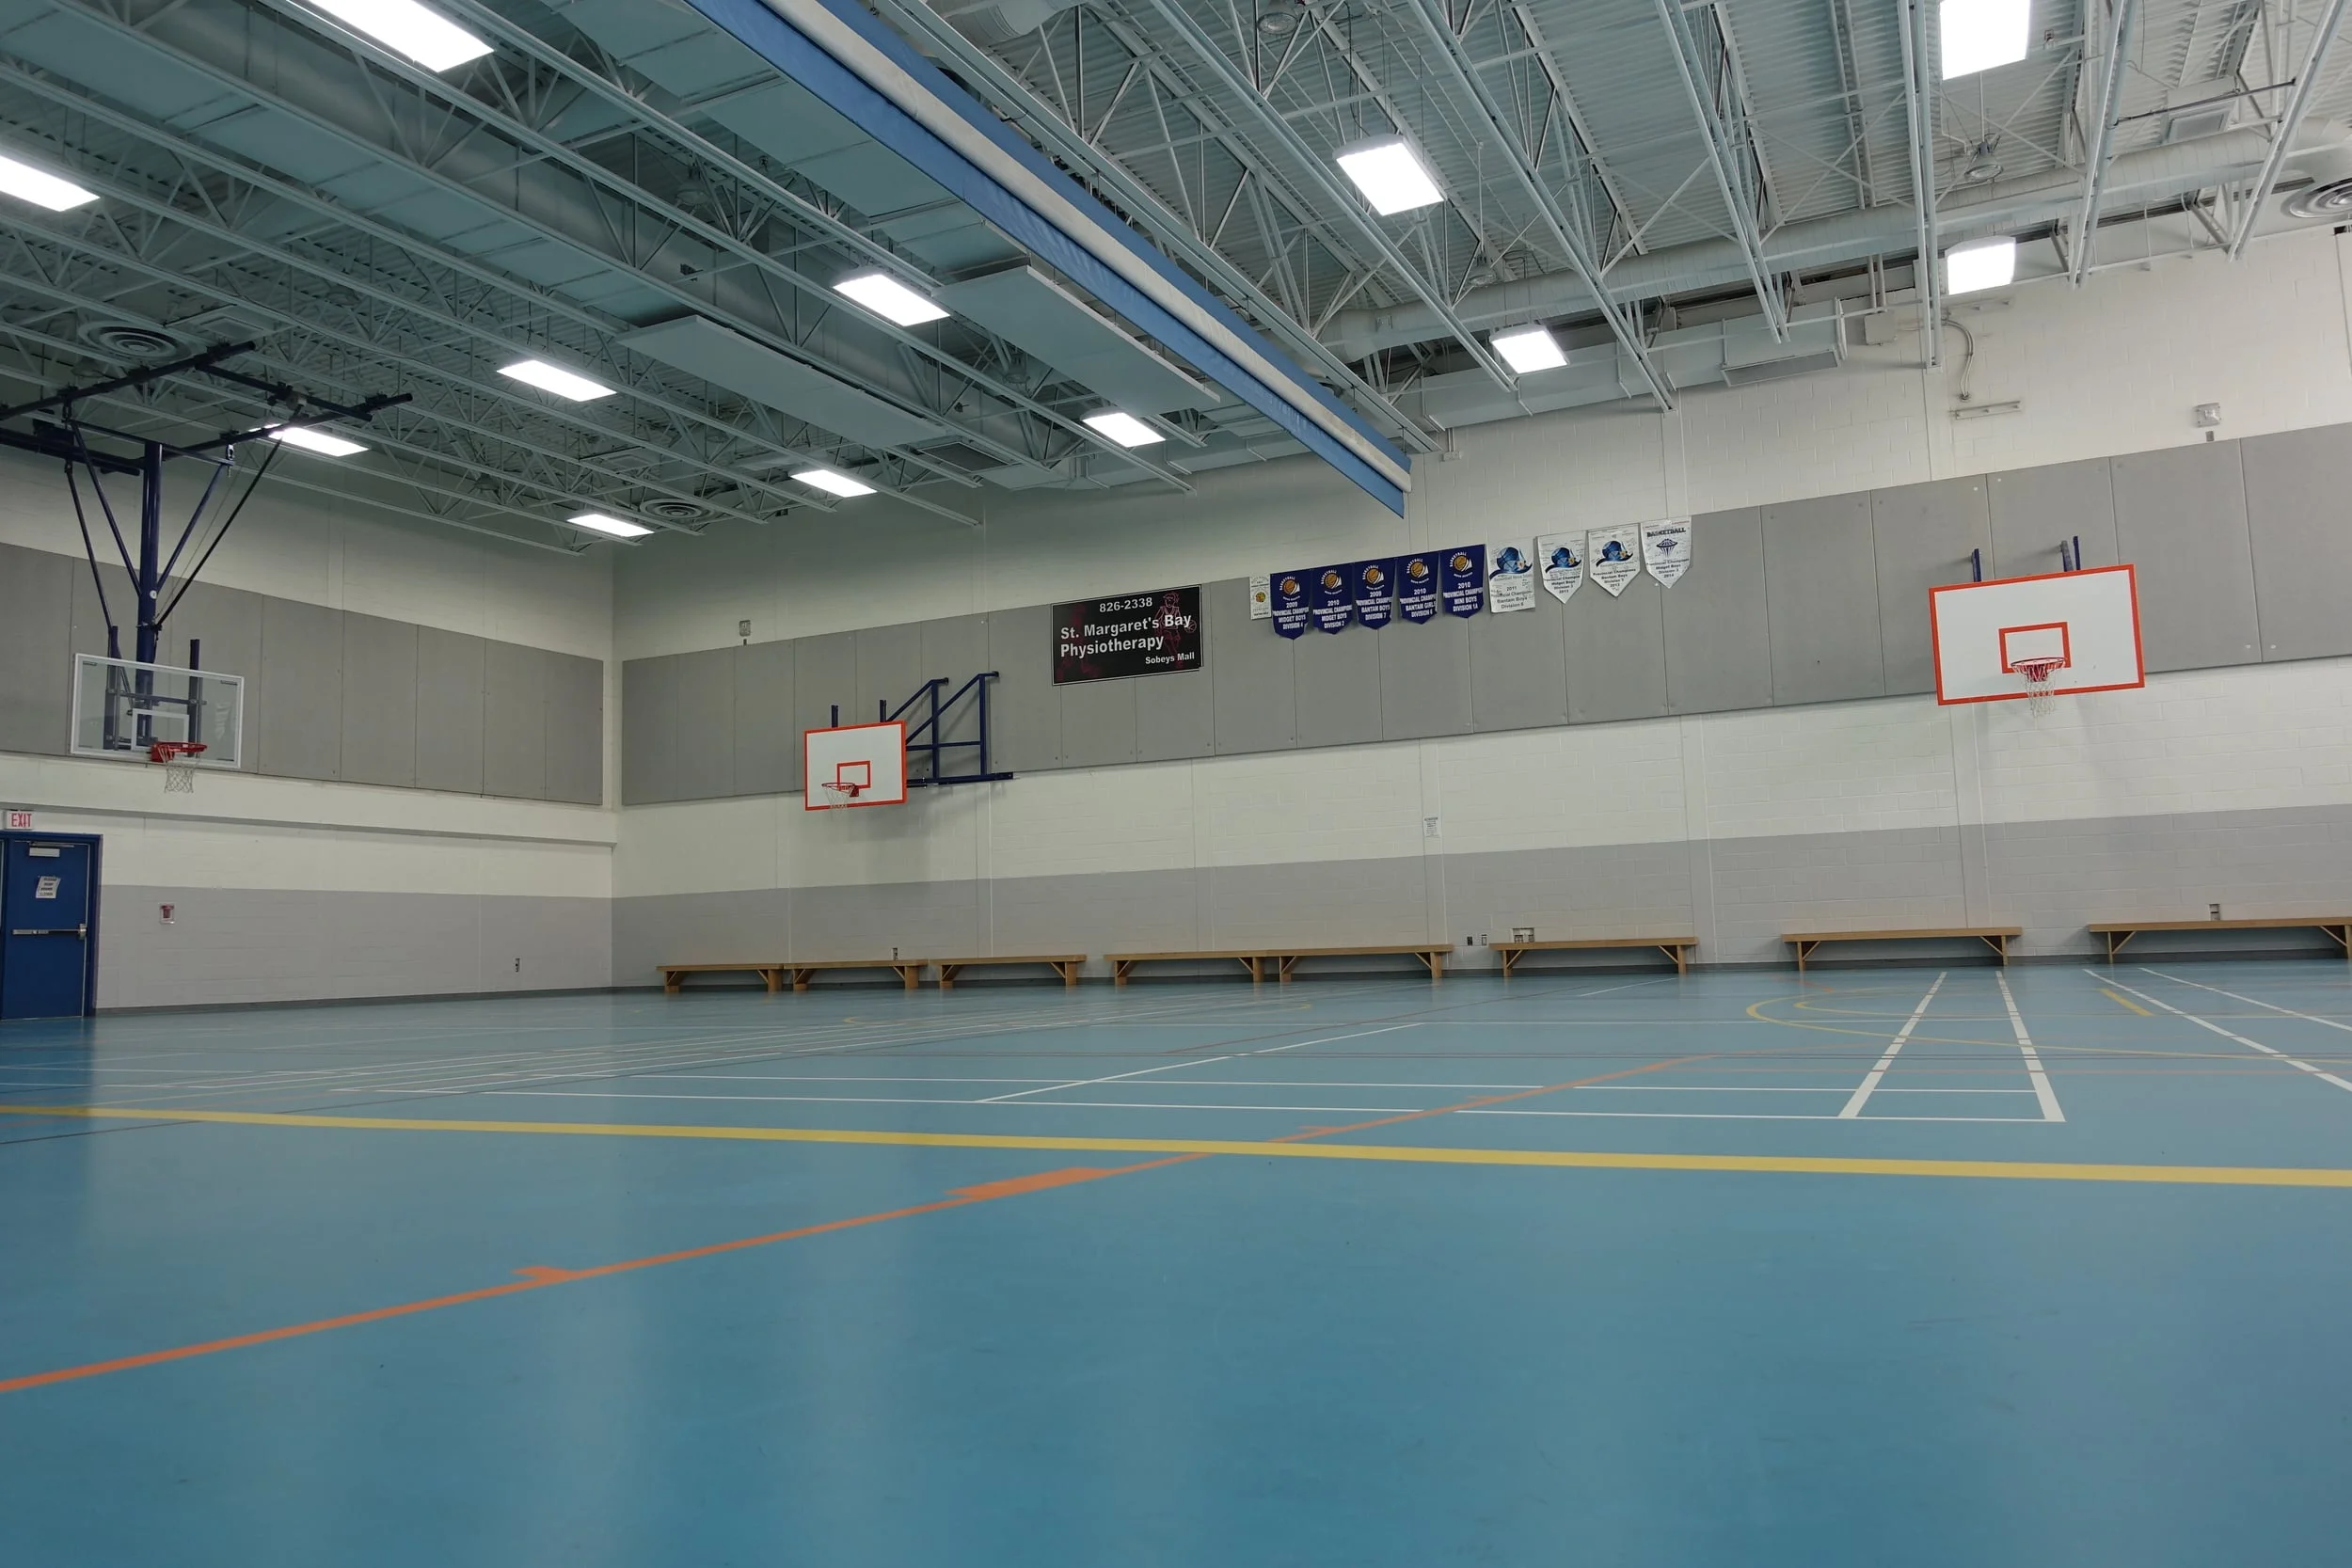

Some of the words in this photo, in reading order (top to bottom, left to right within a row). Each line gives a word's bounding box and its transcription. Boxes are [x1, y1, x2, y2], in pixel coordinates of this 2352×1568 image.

[1646, 528, 1686, 537] BASKETBALL
[1099, 596, 1153, 613] 826-2338
[1060, 626, 1079, 640] St.
[1084, 617, 1159, 637] Margaret's
[1164, 614, 1191, 628] Bay
[1060, 636, 1164, 658] Physiotherapy
[1145, 655, 1175, 664] Sobeys
[1177, 652, 1195, 661] Mall
[11, 813, 32, 828] EXIT
